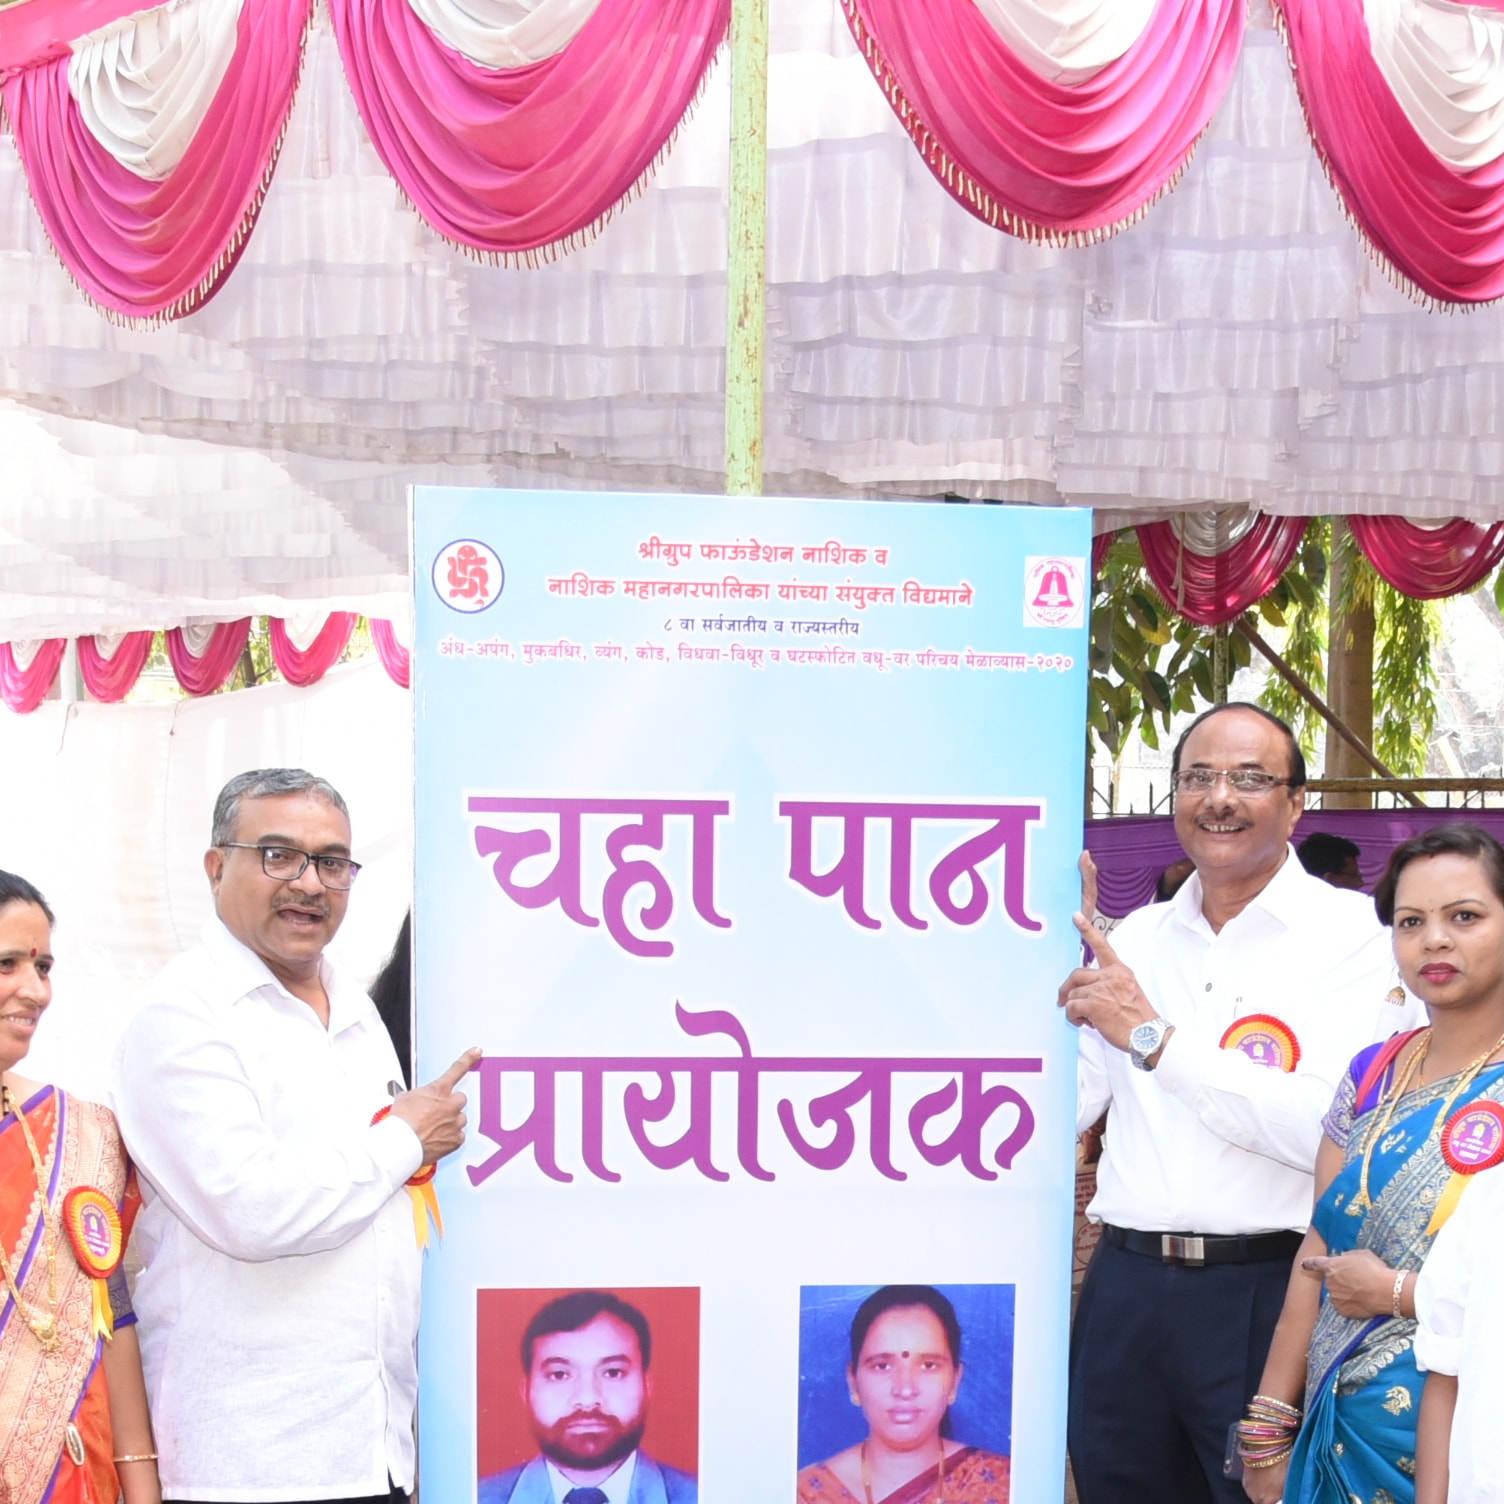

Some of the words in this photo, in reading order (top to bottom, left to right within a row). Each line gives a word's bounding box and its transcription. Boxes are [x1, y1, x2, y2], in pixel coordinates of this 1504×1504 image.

[640, 536, 693, 567] श्रीग्रुप
[700, 538, 794, 563] फाऊंडेशन
[802, 541, 868, 565] नाशिक
[875, 548, 888, 565] व
[548, 572, 616, 597] नाशिक
[623, 576, 771, 600] महानगरपालिका
[777, 578, 828, 602] यांच्या
[835, 579, 895, 610] संयुक्त
[902, 581, 974, 606] विद्यमाने
[663, 618, 672, 632] ८
[679, 618, 695, 632] वा
[701, 613, 767, 633] सर्वजातीय
[774, 619, 784, 633] व
[790, 617, 860, 635] राज्यस्तरीय
[635, 641, 671, 663] कोड,
[770, 649, 780, 662] व
[787, 645, 856, 665] घटस्फोटित
[916, 649, 959, 667] परिचय
[467, 796, 733, 958] चहा
[778, 800, 1043, 932] पान
[465, 998, 1043, 1187] प्रायोजक
